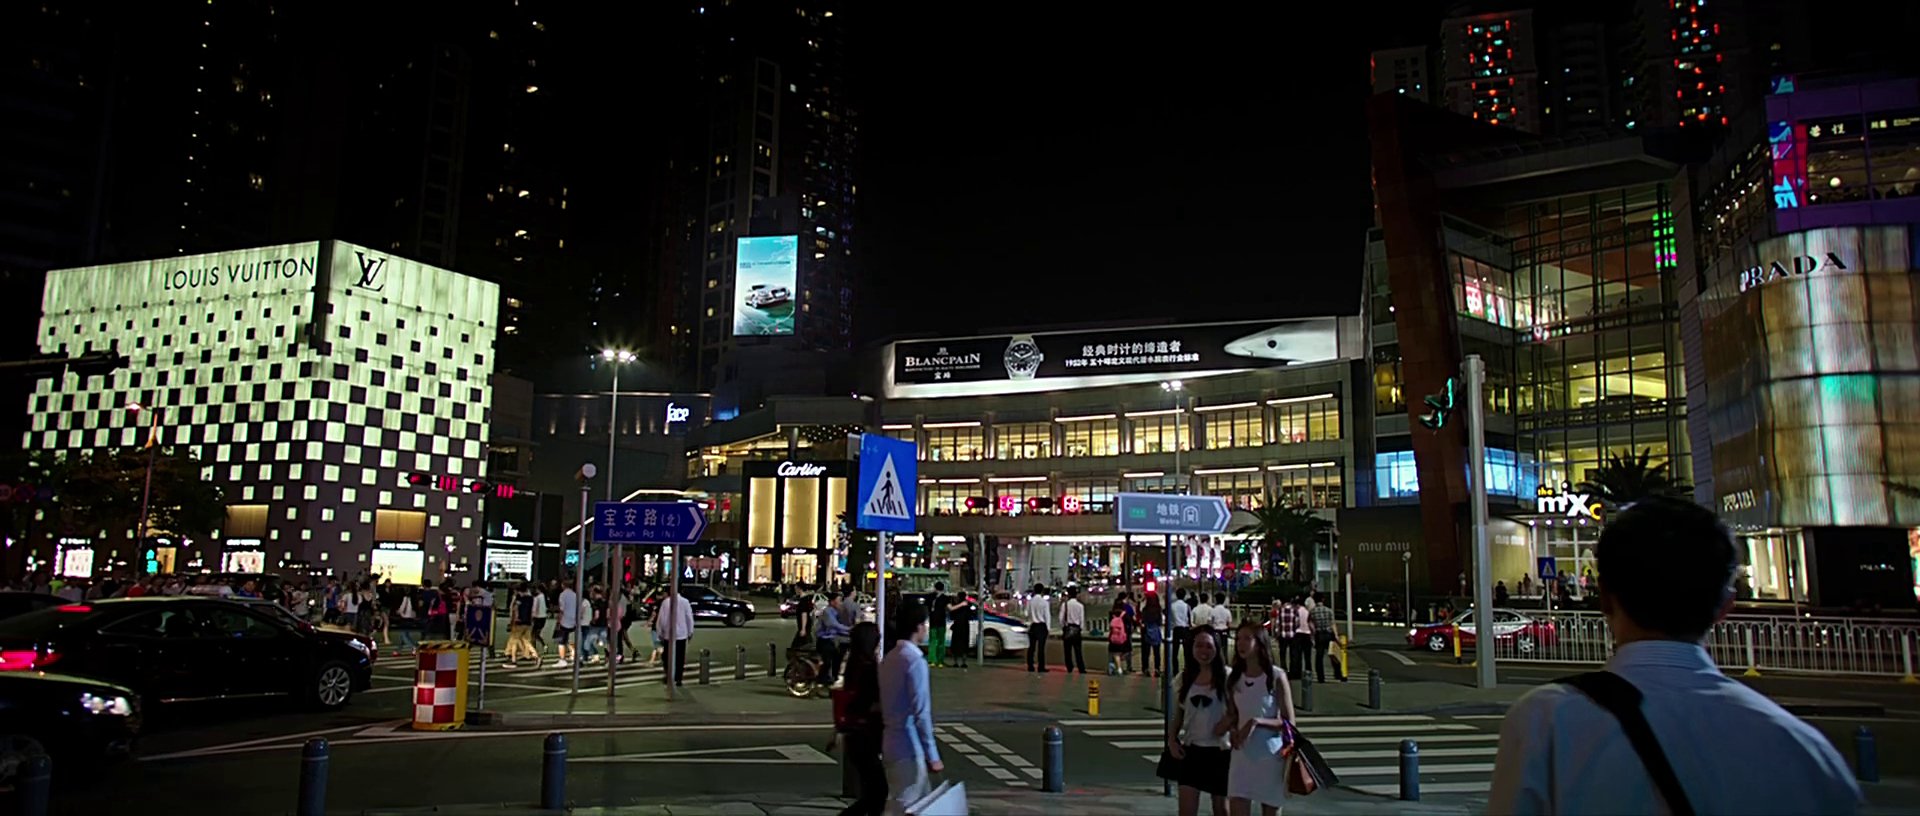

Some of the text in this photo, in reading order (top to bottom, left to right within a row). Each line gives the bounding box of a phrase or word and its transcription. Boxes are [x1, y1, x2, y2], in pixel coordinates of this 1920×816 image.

[164, 256, 315, 291] LOUIS VUITTON
[1739, 252, 1847, 292] PRADA
[1082, 340, 1181, 357] 经典时计的缔造者
[904, 352, 981, 368] BLANCPAIN
[777, 461, 827, 476] Cartier
[1537, 487, 1553, 496] the
[1156, 503, 1180, 516] 地铁
[1159, 517, 1180, 525] Metro
